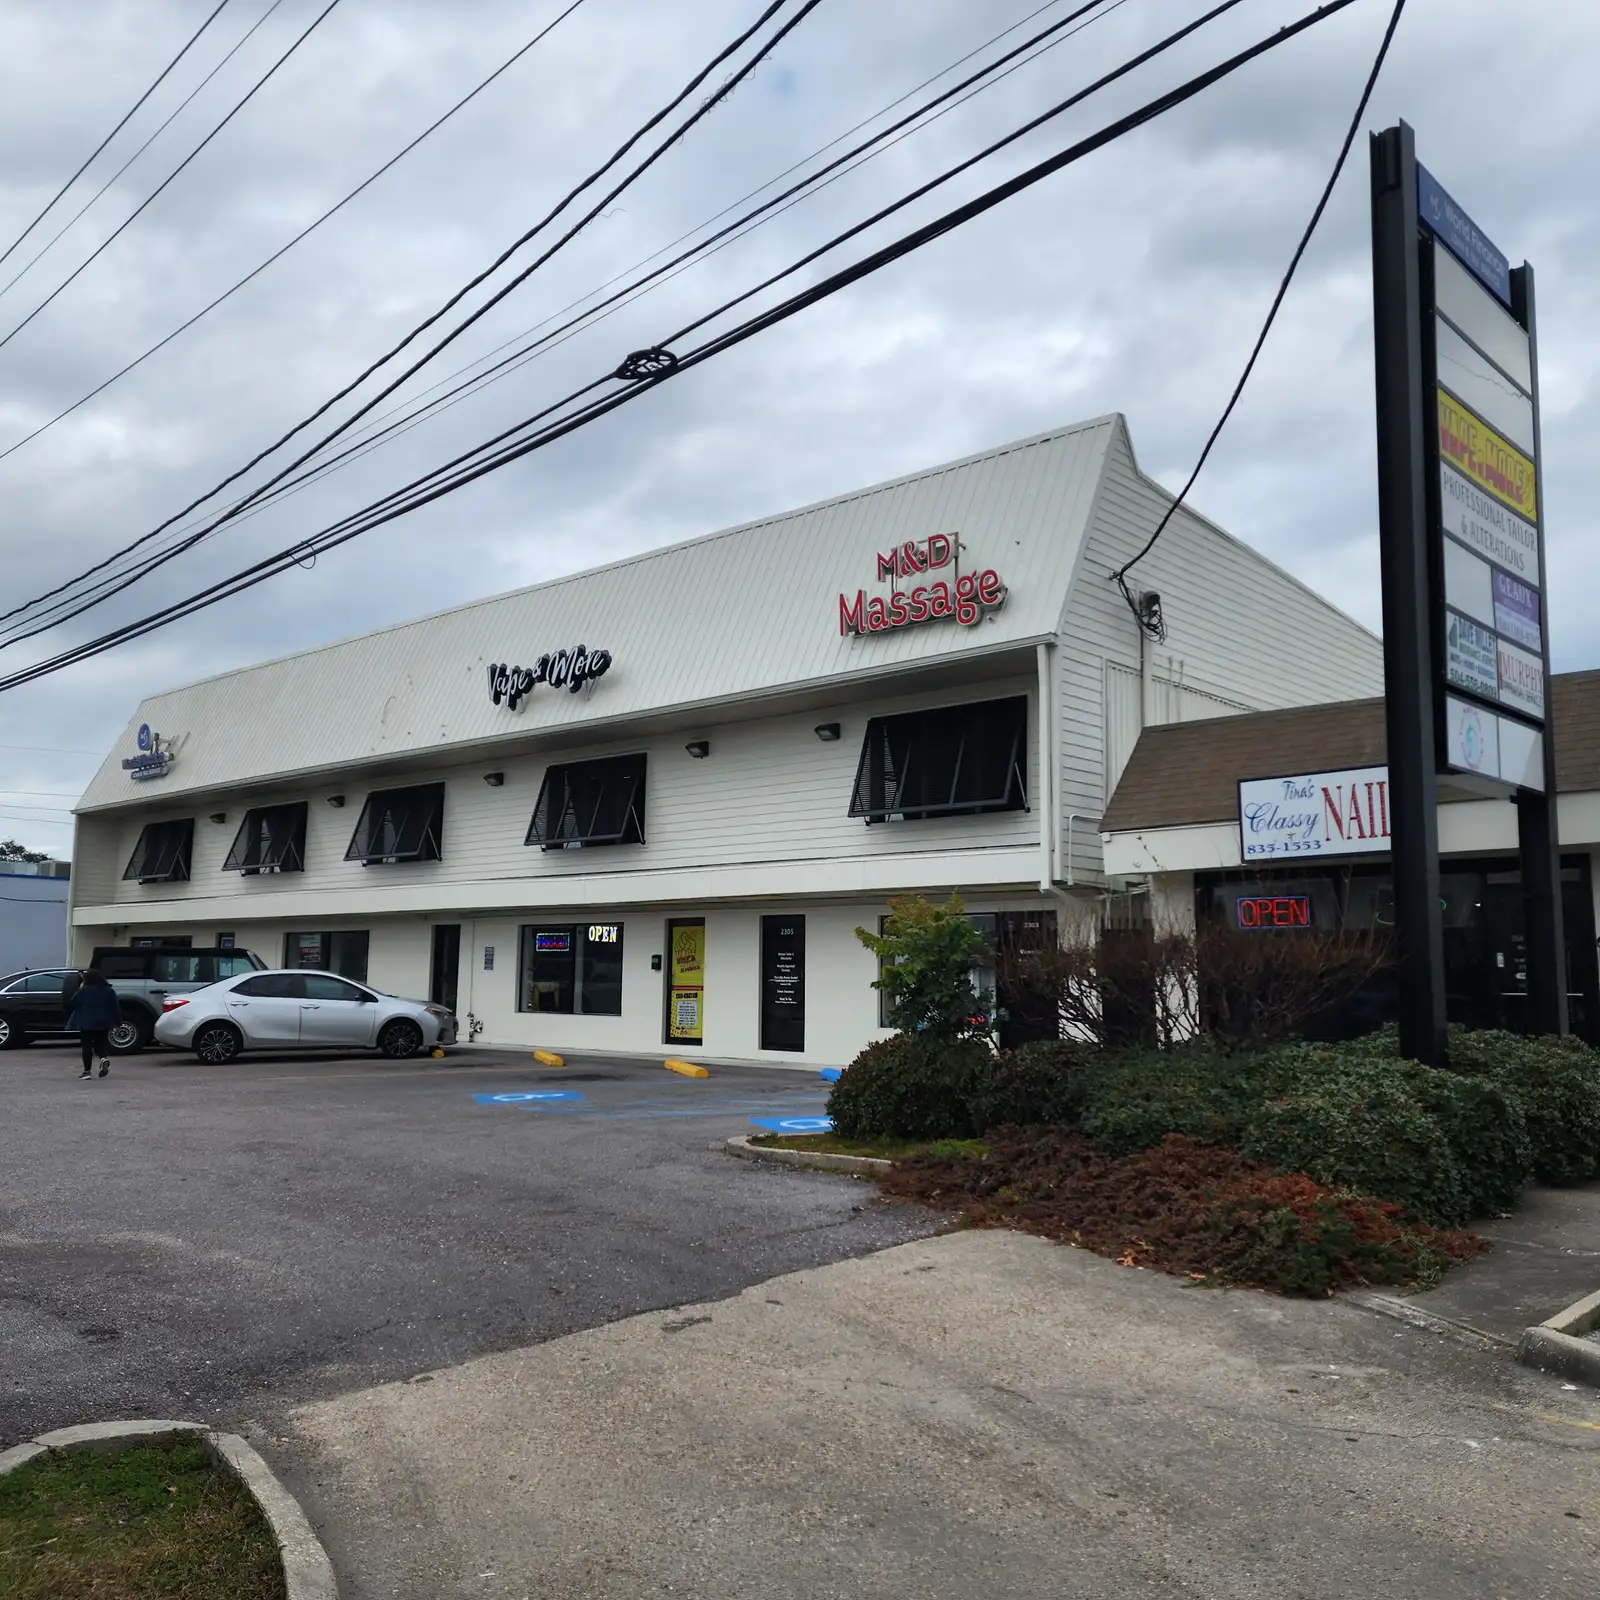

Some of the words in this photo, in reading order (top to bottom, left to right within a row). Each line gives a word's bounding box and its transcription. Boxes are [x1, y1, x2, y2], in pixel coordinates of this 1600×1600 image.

[1443, 198, 1470, 242] World
[1471, 229, 1505, 278] Finance
[1443, 471, 1505, 533] PROFESSIONAL
[1507, 517, 1536, 552] TAILOR
[876, 533, 954, 582] M&D
[1461, 514, 1469, 535] &
[1469, 520, 1525, 572] ALTERATIONS
[839, 569, 1002, 637] Massage
[1498, 574, 1532, 608] GEAUX
[487, 664, 532, 708] Vape
[532, 654, 547, 681] &
[546, 645, 609, 691] More
[1499, 650, 1543, 694] MURPHY
[1282, 778, 1315, 802] Tina's
[1244, 803, 1320, 840] Classy
[1247, 840, 1322, 855] 835-1553
[1240, 898, 1308, 926] OPEN
[588, 926, 618, 943] OPEN
